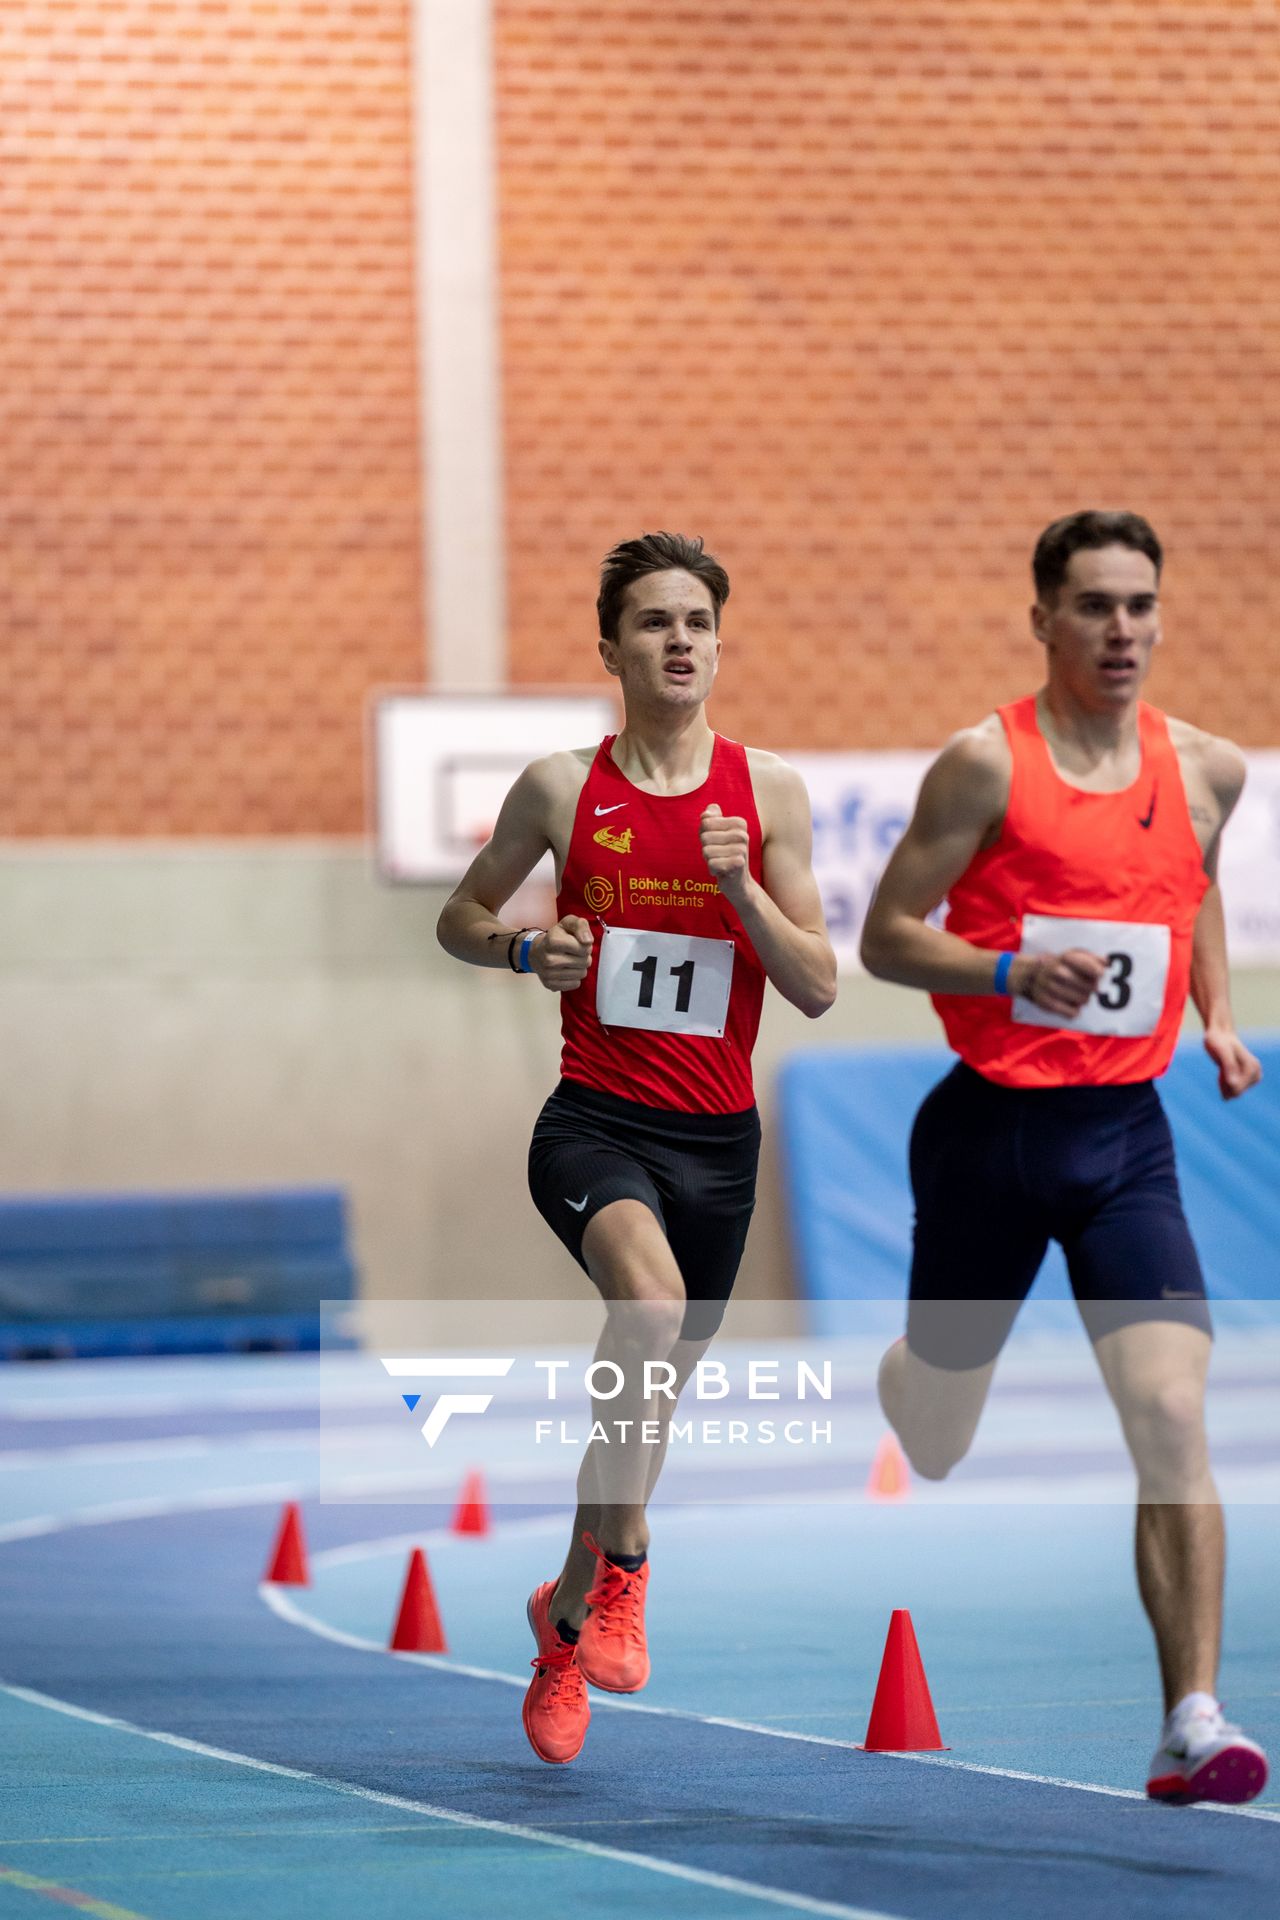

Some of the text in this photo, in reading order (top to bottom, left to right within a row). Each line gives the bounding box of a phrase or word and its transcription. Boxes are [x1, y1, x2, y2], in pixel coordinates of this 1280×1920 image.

[629, 877, 669, 891] Böhke
[672, 879, 682, 892] &
[629, 892, 705, 908] Consultants
[632, 955, 695, 1013] 11
[1097, 952, 1134, 1011] 3
